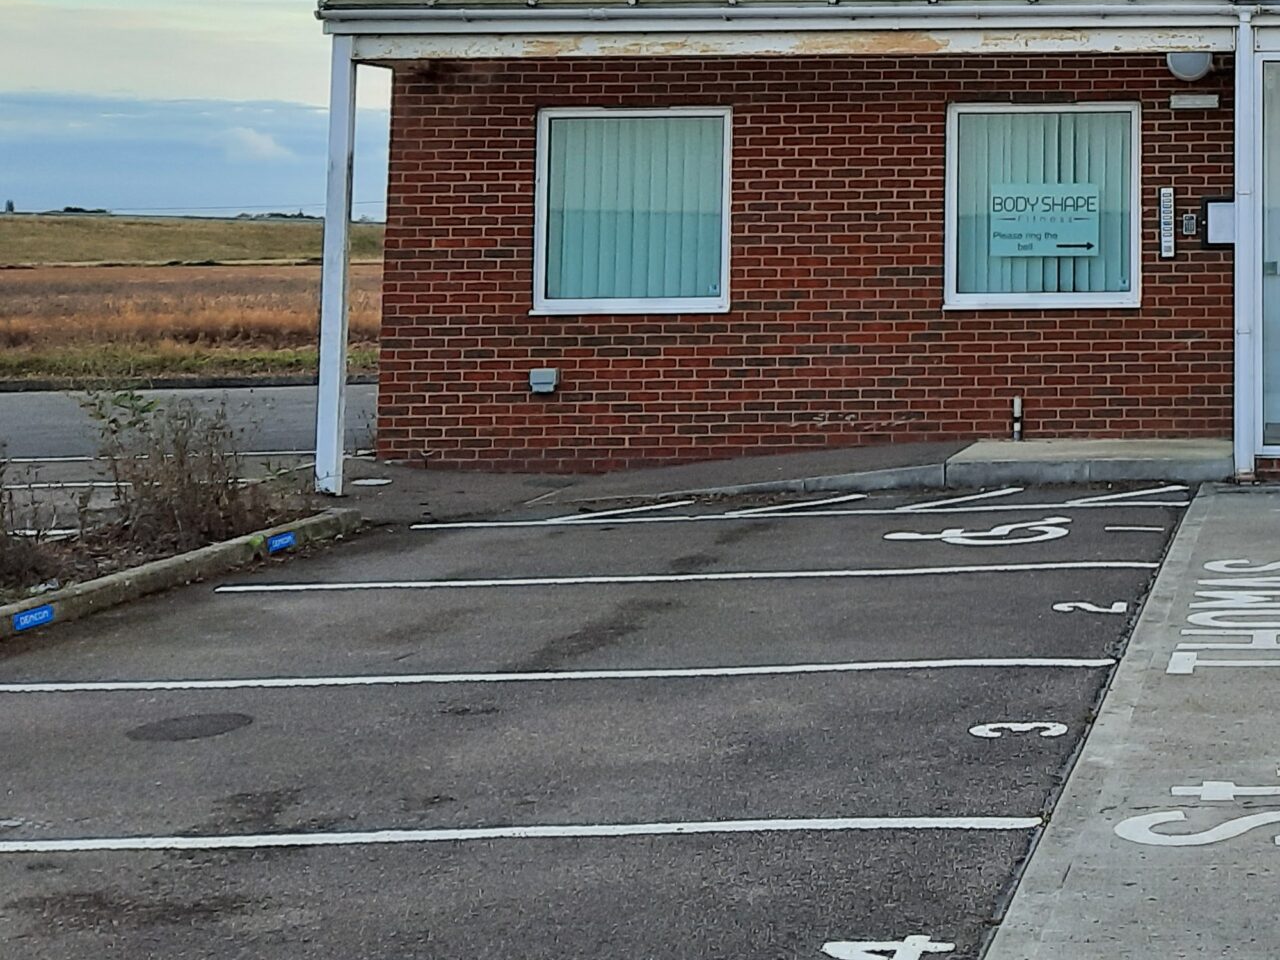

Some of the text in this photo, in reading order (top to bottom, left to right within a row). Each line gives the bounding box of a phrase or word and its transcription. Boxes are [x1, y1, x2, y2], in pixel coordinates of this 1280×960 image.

[992, 231, 1058, 241] Please ring the
[1017, 242, 1033, 251] bell
[1051, 600, 1128, 614] 2
[968, 720, 1069, 738] 3
